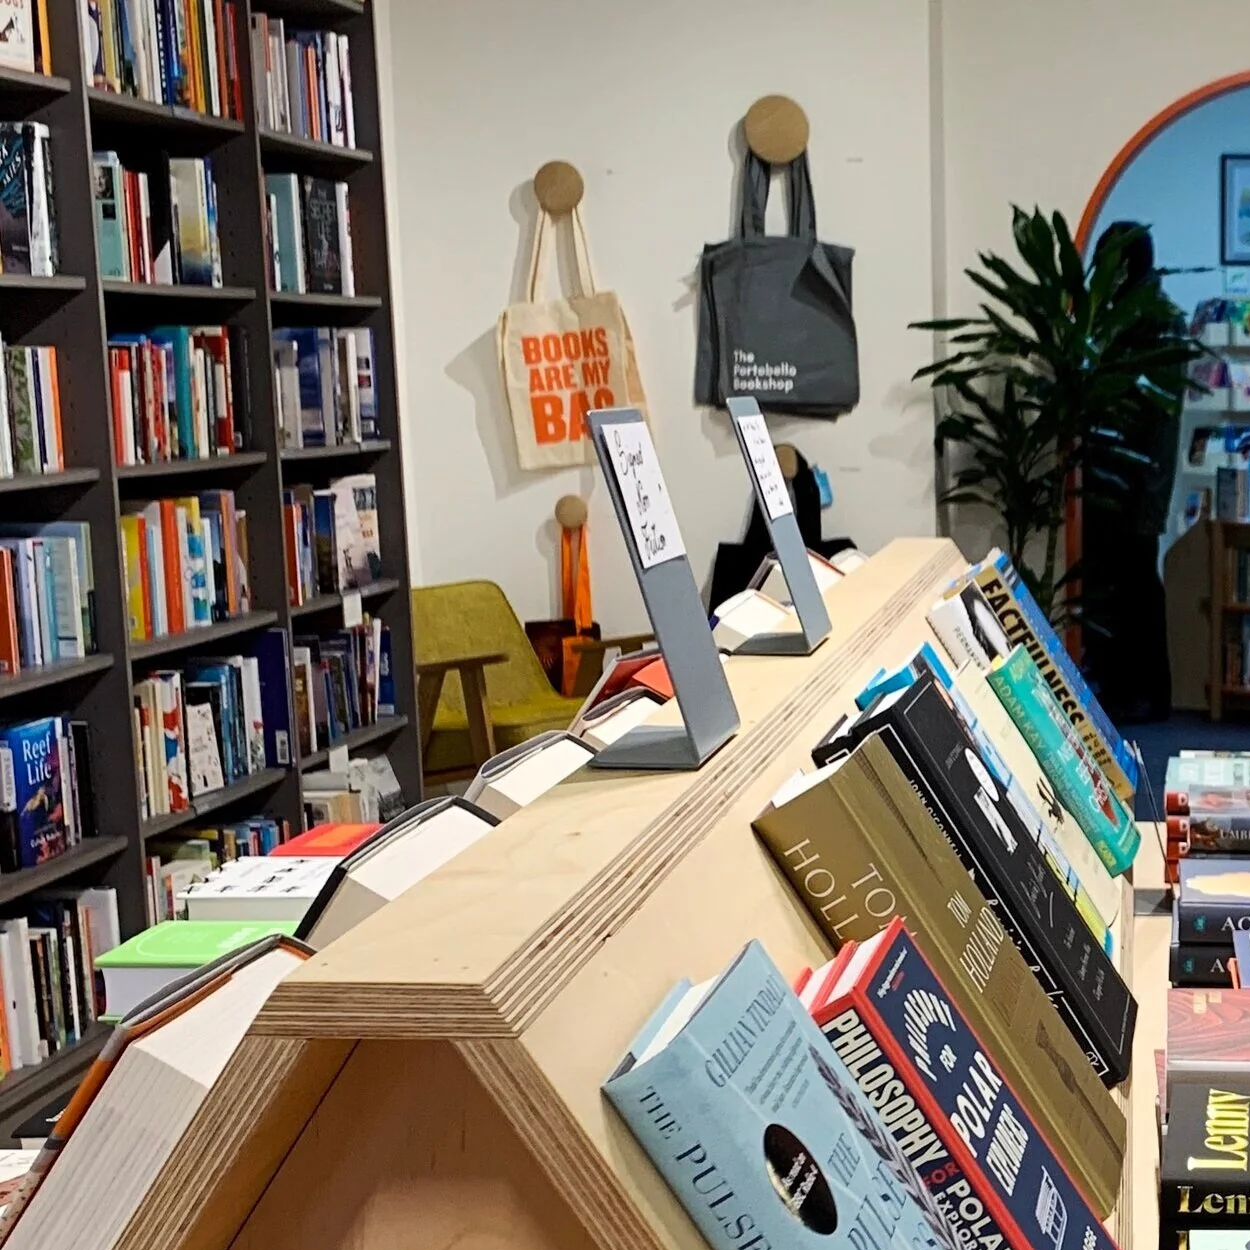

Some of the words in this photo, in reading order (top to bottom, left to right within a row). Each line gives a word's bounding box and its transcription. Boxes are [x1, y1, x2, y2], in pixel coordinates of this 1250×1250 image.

[521, 327, 609, 365] BOOKS
[733, 349, 755, 363] The
[529, 362, 578, 392] ARE
[581, 358, 611, 388] MY
[733, 362, 797, 376] Portobello
[733, 376, 794, 394] Bookshop
[22, 731, 51, 762] Reef
[26, 759, 52, 786] Life
[784, 838, 860, 940] HOLL
[947, 889, 973, 928] TOM
[1220, 917, 1237, 931] A
[959, 906, 1005, 994] HOLLAND
[704, 1019, 758, 1088] GILLIAN
[904, 989, 957, 1082] PHILOSOPHY
[938, 1044, 957, 1073] FOR
[820, 1009, 948, 1169] PHILOSOPHY
[950, 1051, 1003, 1158] POLAR
[639, 1085, 682, 1140] THE
[828, 1132, 860, 1187] THE
[986, 1103, 1029, 1197] EXPLORERS
